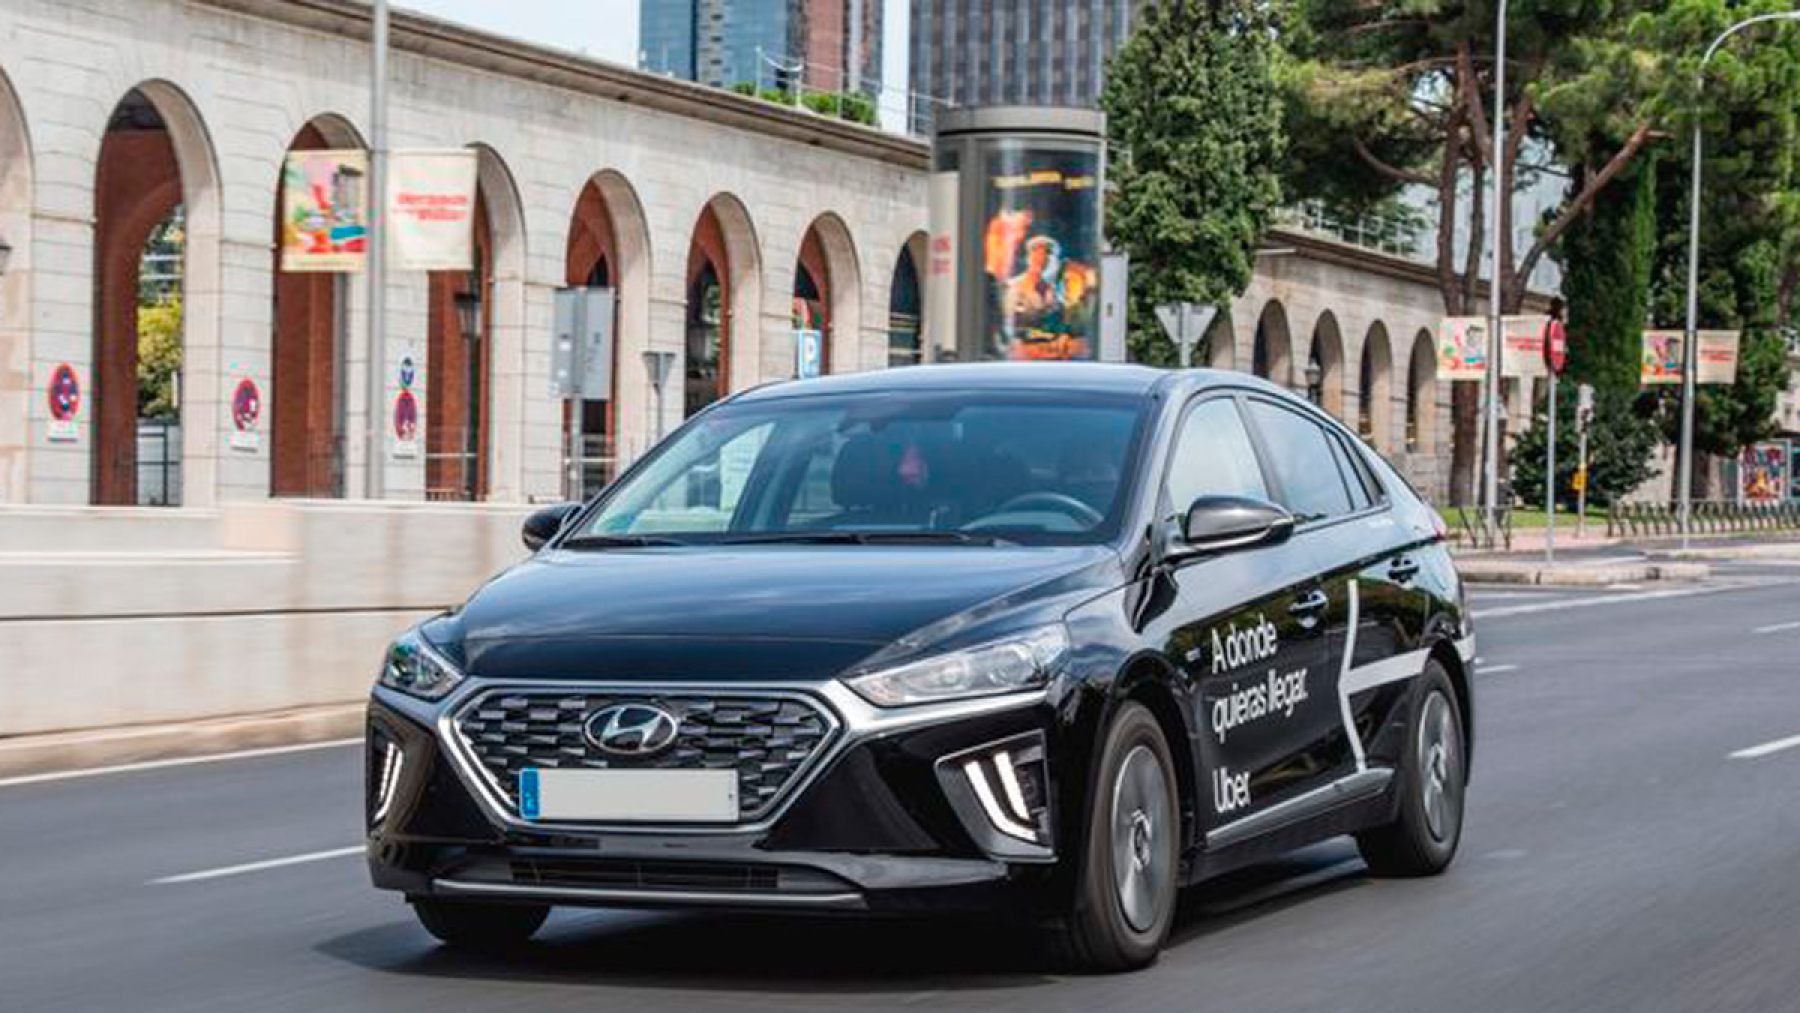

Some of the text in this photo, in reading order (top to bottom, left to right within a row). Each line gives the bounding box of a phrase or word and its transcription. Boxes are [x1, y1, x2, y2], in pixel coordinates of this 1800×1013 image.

[1211, 612, 1277, 674] A donde
[1212, 668, 1308, 744] quieras llegar.
[1212, 767, 1250, 813] Uber
